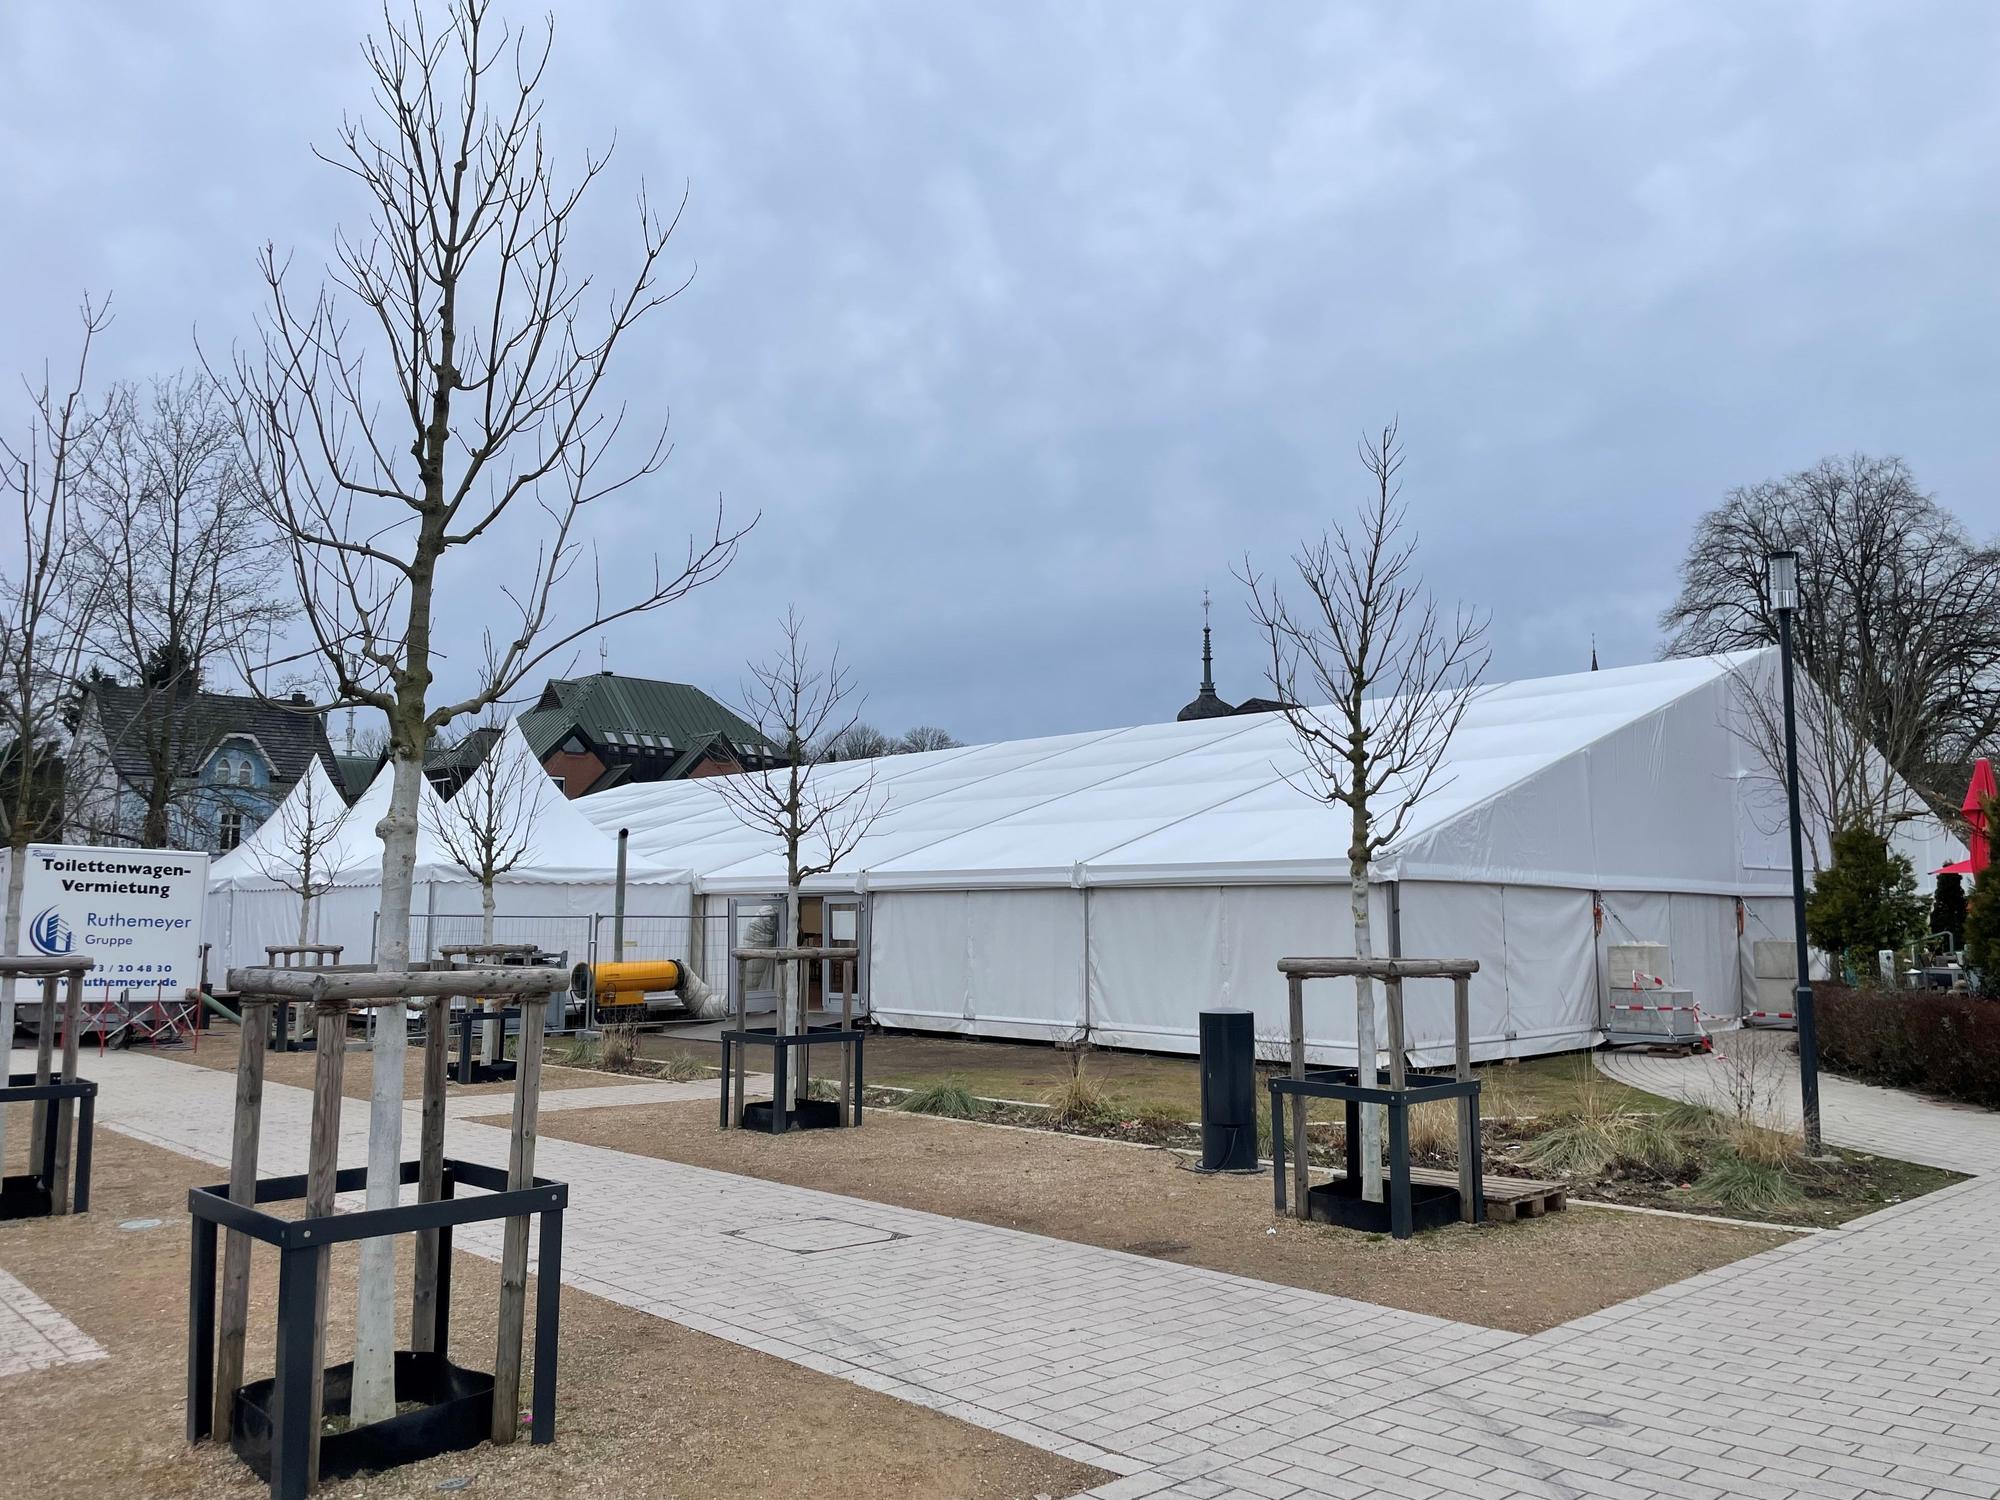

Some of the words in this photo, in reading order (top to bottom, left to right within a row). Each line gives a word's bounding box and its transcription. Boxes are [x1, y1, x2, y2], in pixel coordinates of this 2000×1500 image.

[42, 858, 191, 879] Toilettenwagen-
[61, 879, 170, 898] Vermietung
[87, 912, 192, 931] Ruthemeyer
[85, 934, 133, 947] Gruppe
[118, 964, 134, 972] 20
[136, 964, 152, 972] 48
[157, 964, 172, 972] 30
